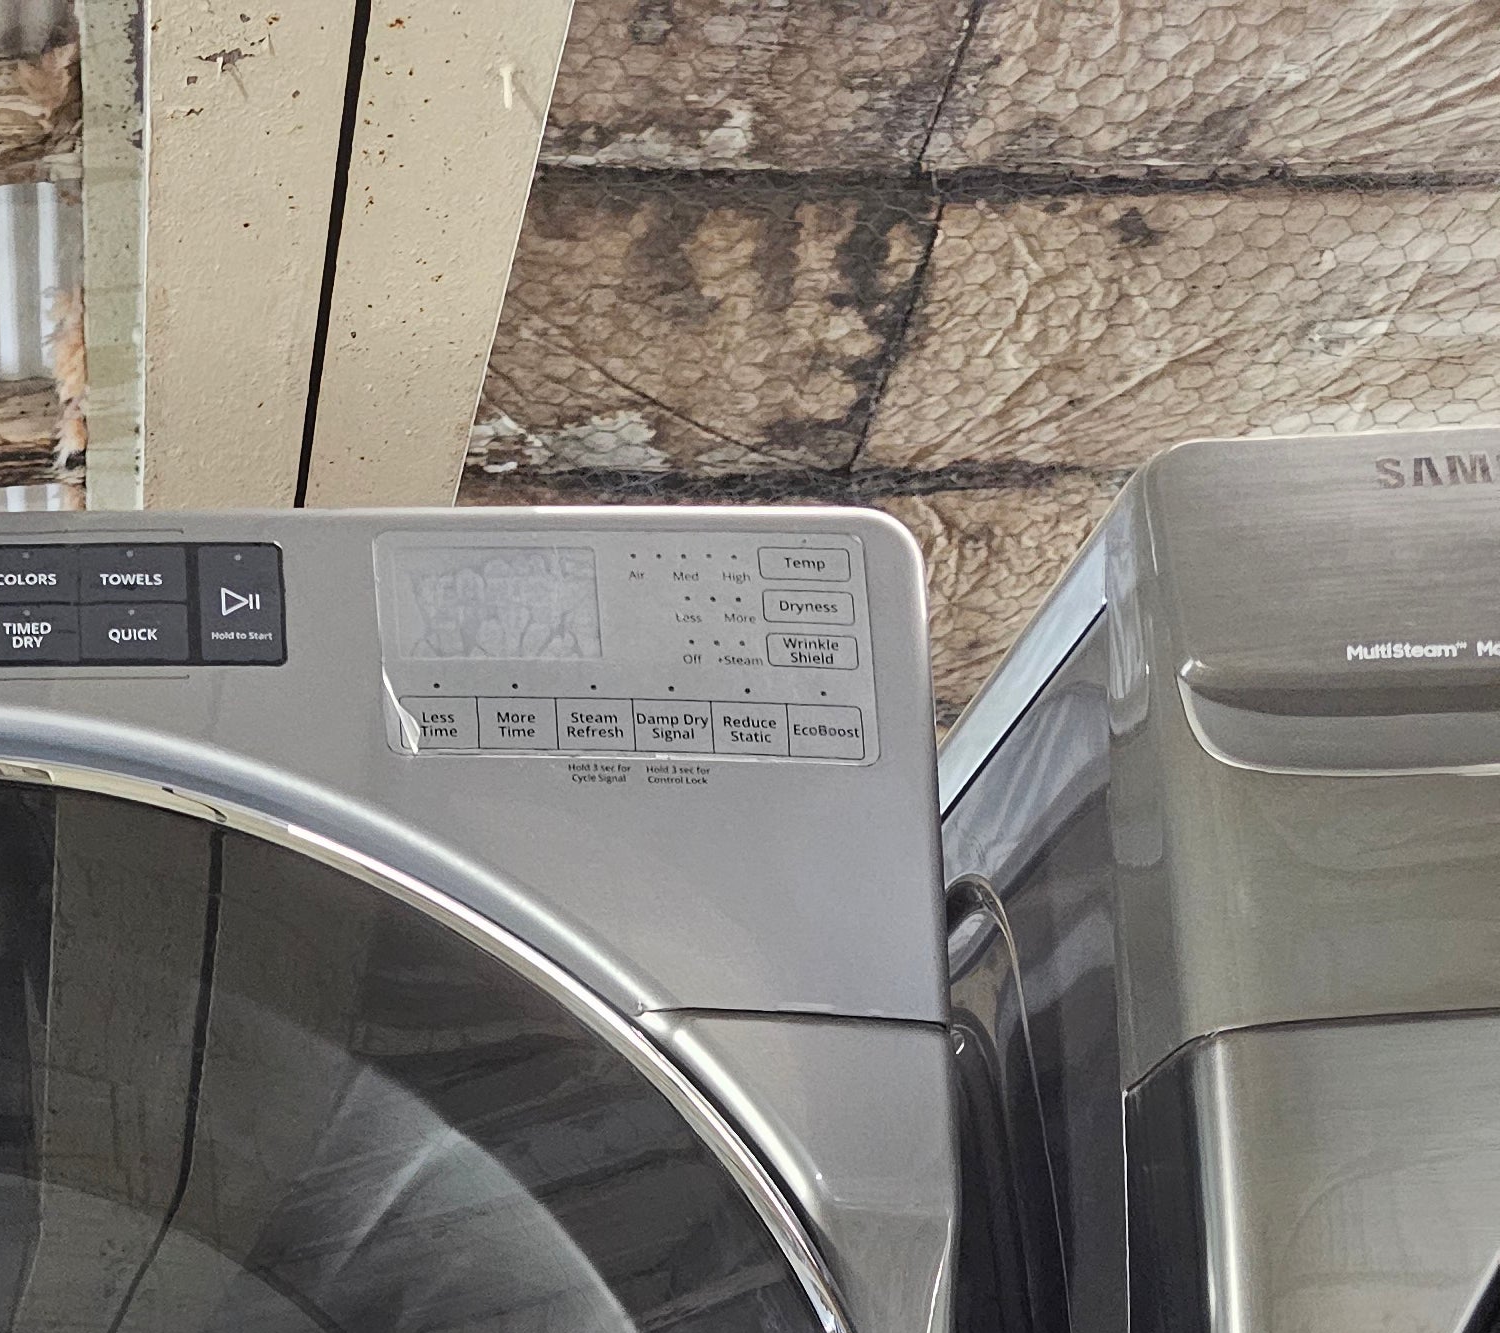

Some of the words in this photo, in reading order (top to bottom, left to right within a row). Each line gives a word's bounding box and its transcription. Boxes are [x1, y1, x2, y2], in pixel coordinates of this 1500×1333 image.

[1376, 454, 1500, 489] SAM
[784, 557, 826, 572] Temp
[100, 573, 163, 586] TOWELS
[628, 570, 645, 580] Air
[673, 571, 699, 582] Med
[722, 571, 751, 584] High
[779, 600, 838, 615] Dryness
[675, 612, 703, 623] Less
[724, 612, 757, 624] More
[3, 622, 52, 636] TIMED
[108, 628, 158, 643] QUICK
[12, 636, 44, 649] DRY
[211, 631, 235, 640] Hold
[235, 632, 247, 640] to
[248, 631, 273, 641] Start
[782, 637, 839, 651] Wrinkle
[682, 654, 703, 665] Off
[790, 651, 834, 665] Shield
[422, 711, 455, 724] Less
[496, 711, 536, 724] More
[570, 711, 618, 724] Steam
[635, 713, 679, 726] Damp
[683, 714, 708, 728] Dry
[722, 715, 777, 729] Reduce
[420, 725, 458, 738] Time
[498, 725, 535, 738] Time
[567, 725, 624, 738] Refresh
[652, 727, 695, 742] Signal
[731, 731, 772, 744] Static
[793, 724, 860, 738] EcoBoost
[568, 763, 591, 772] Hold
[617, 764, 631, 772] for
[646, 765, 669, 774] Hold
[696, 765, 710, 775] for
[571, 773, 597, 784] Cycle
[597, 774, 627, 785] Signal
[647, 775, 684, 784] Control
[686, 776, 709, 785] Lock
